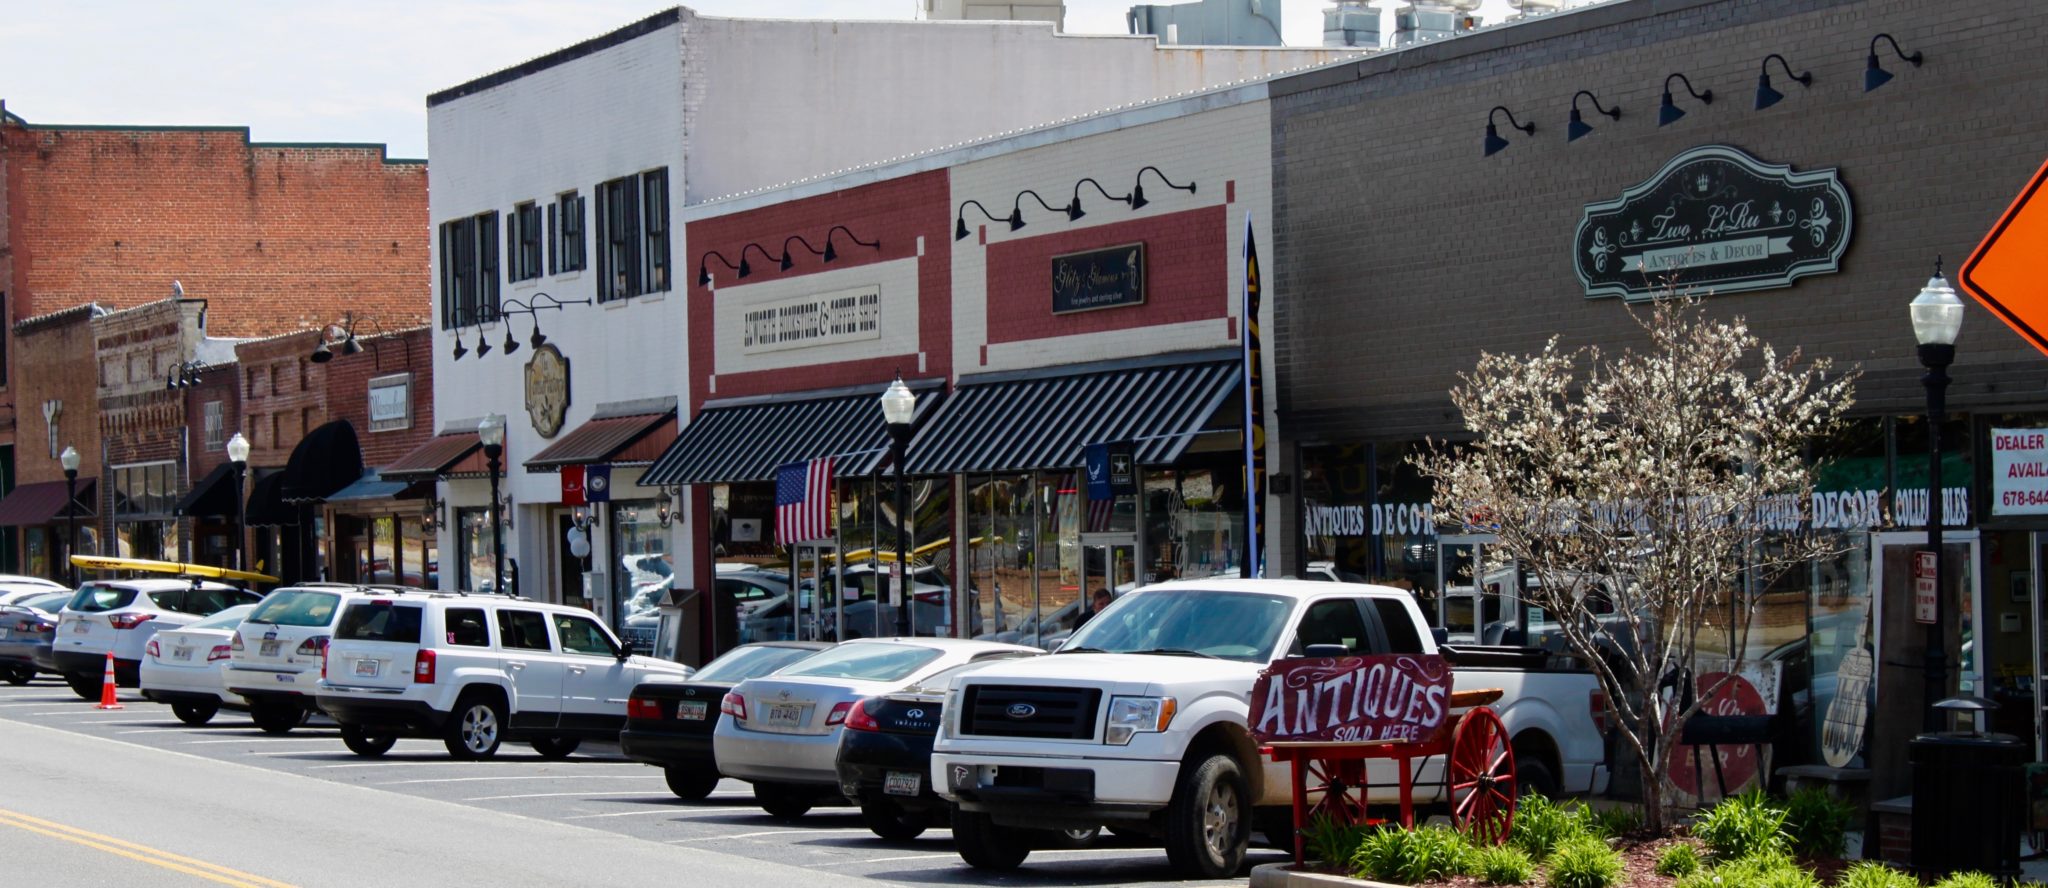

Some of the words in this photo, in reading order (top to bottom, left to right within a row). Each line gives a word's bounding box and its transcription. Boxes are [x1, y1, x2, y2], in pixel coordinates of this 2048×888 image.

[1648, 207, 1691, 240] Two
[1702, 200, 1761, 233] LiRu
[1711, 247, 1718, 261] &
[1725, 243, 1763, 259] DECOR
[745, 309, 776, 347] ACWORTH
[780, 302, 818, 342] BOOKSTORE
[820, 301, 829, 336] &
[831, 297, 856, 335] COFFEE
[860, 294, 878, 332] SHOP
[1996, 434, 2044, 451] DEALER
[2008, 462, 2048, 478] AVAIL
[1305, 505, 1364, 536] ANTIQUES
[1372, 503, 1435, 535] DECOR
[1811, 488, 1882, 529] DECOR
[1012, 704, 1028, 715] Ford
[1256, 663, 1446, 735] ANTIQUES
[1333, 725, 1373, 742] SOLD
[1381, 724, 1419, 741] HERE
